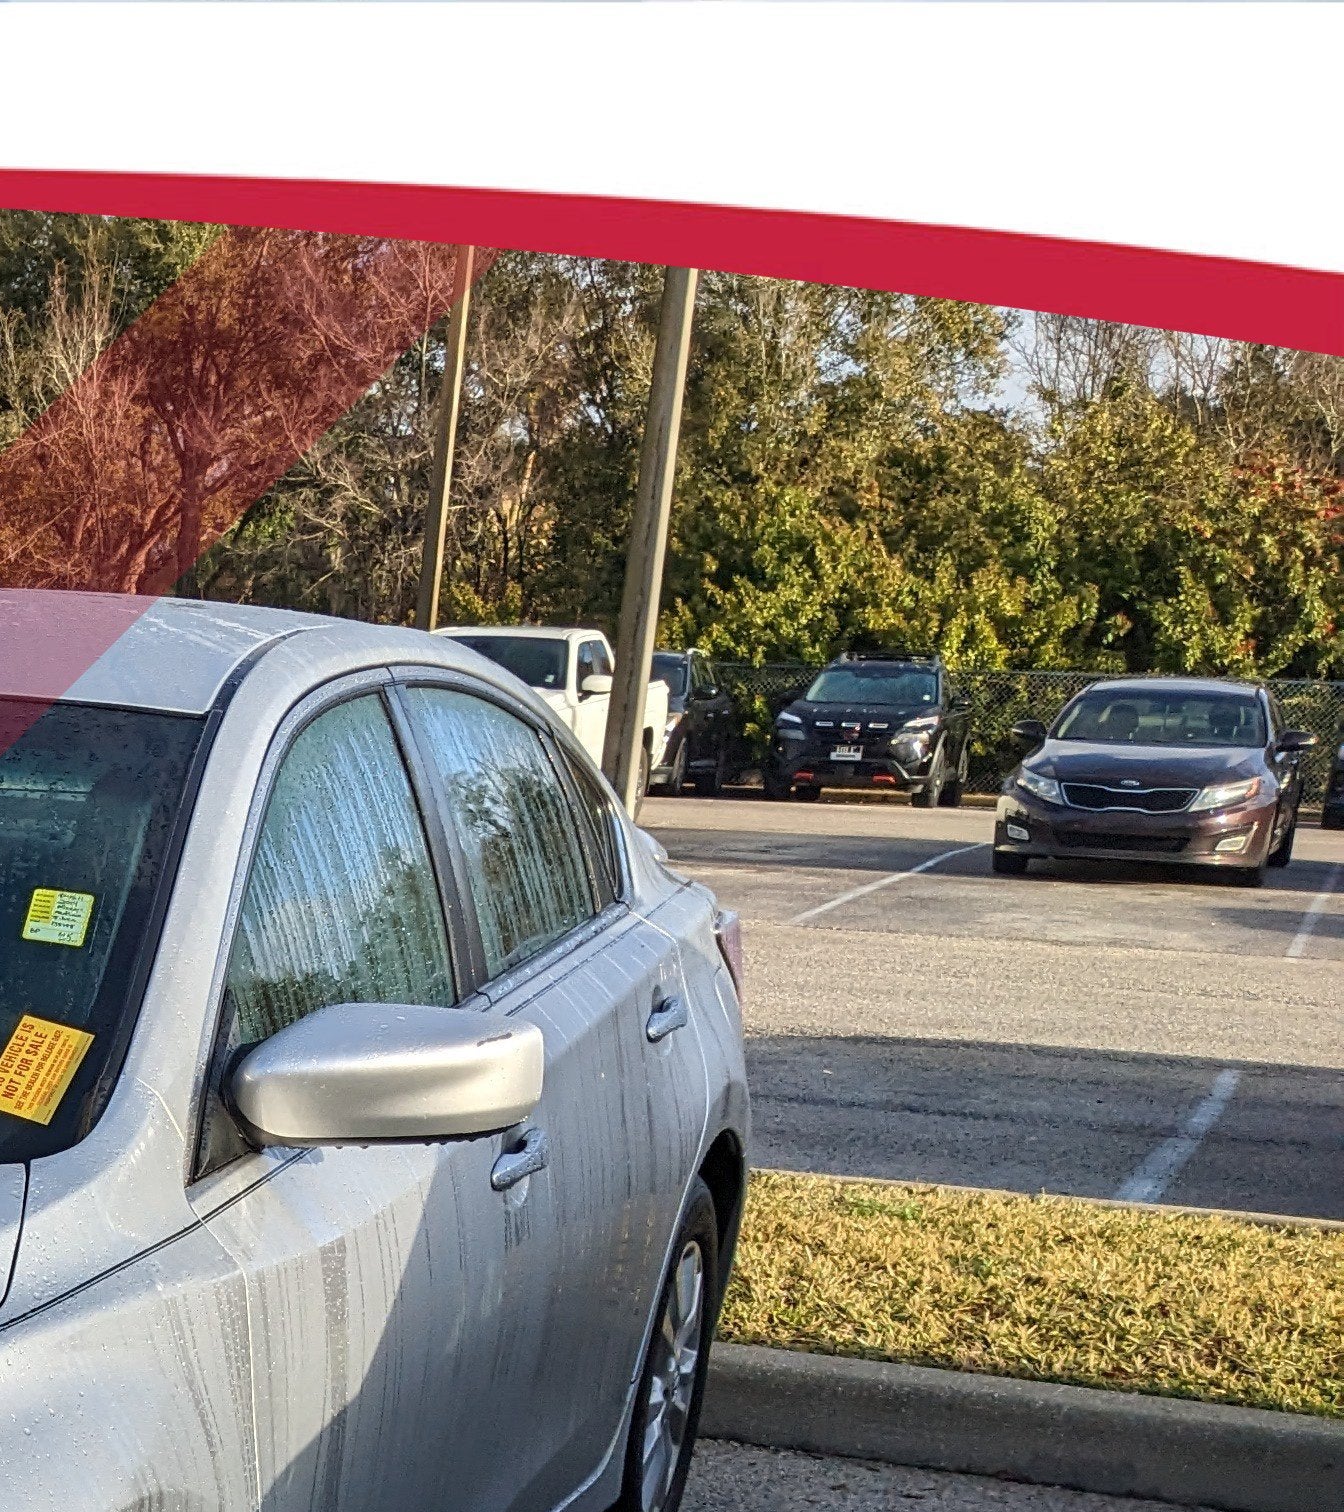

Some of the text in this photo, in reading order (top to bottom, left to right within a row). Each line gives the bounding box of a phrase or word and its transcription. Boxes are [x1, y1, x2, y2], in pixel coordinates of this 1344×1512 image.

[20, 1022, 35, 1033] IS
[1, 1078, 22, 1100] NOT
[14, 1057, 33, 1077] FOR
[25, 1031, 48, 1057] SALE
